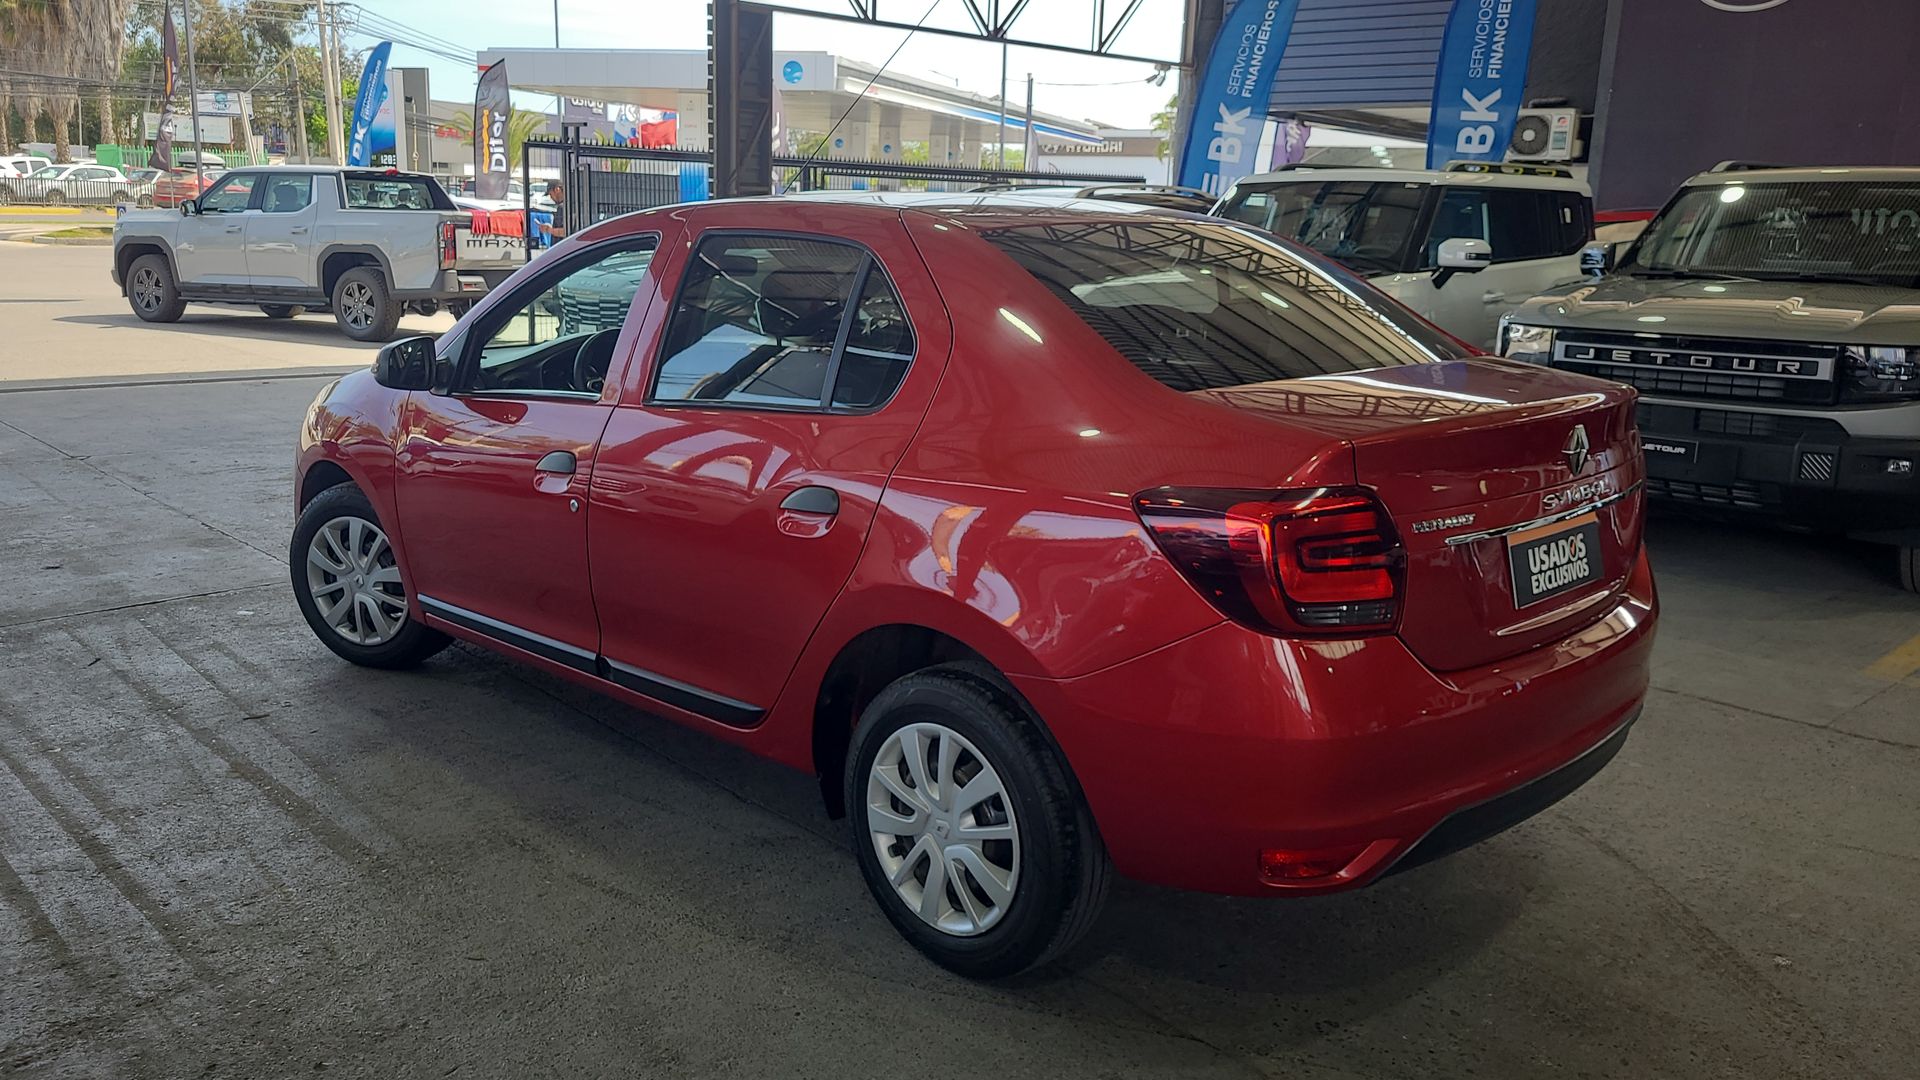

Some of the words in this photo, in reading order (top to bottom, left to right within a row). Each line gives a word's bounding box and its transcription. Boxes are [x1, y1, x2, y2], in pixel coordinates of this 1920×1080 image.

[1226, 24, 1257, 96] SERVICIOS
[1241, 0, 1280, 98] FINANCIEROS
[1468, 0, 1494, 78] SERVICIOS
[1487, 0, 1513, 79] FINANCIE
[1207, 102, 1251, 165] BK
[1456, 87, 1504, 154] BK
[1575, 347, 1801, 374] JETOUR
[1641, 443, 1686, 454] JETOUR
[1542, 479, 1611, 510] SYMBOL
[1527, 532, 1587, 574] USADOS
[1530, 557, 1590, 595] EXCLUSIVOS
